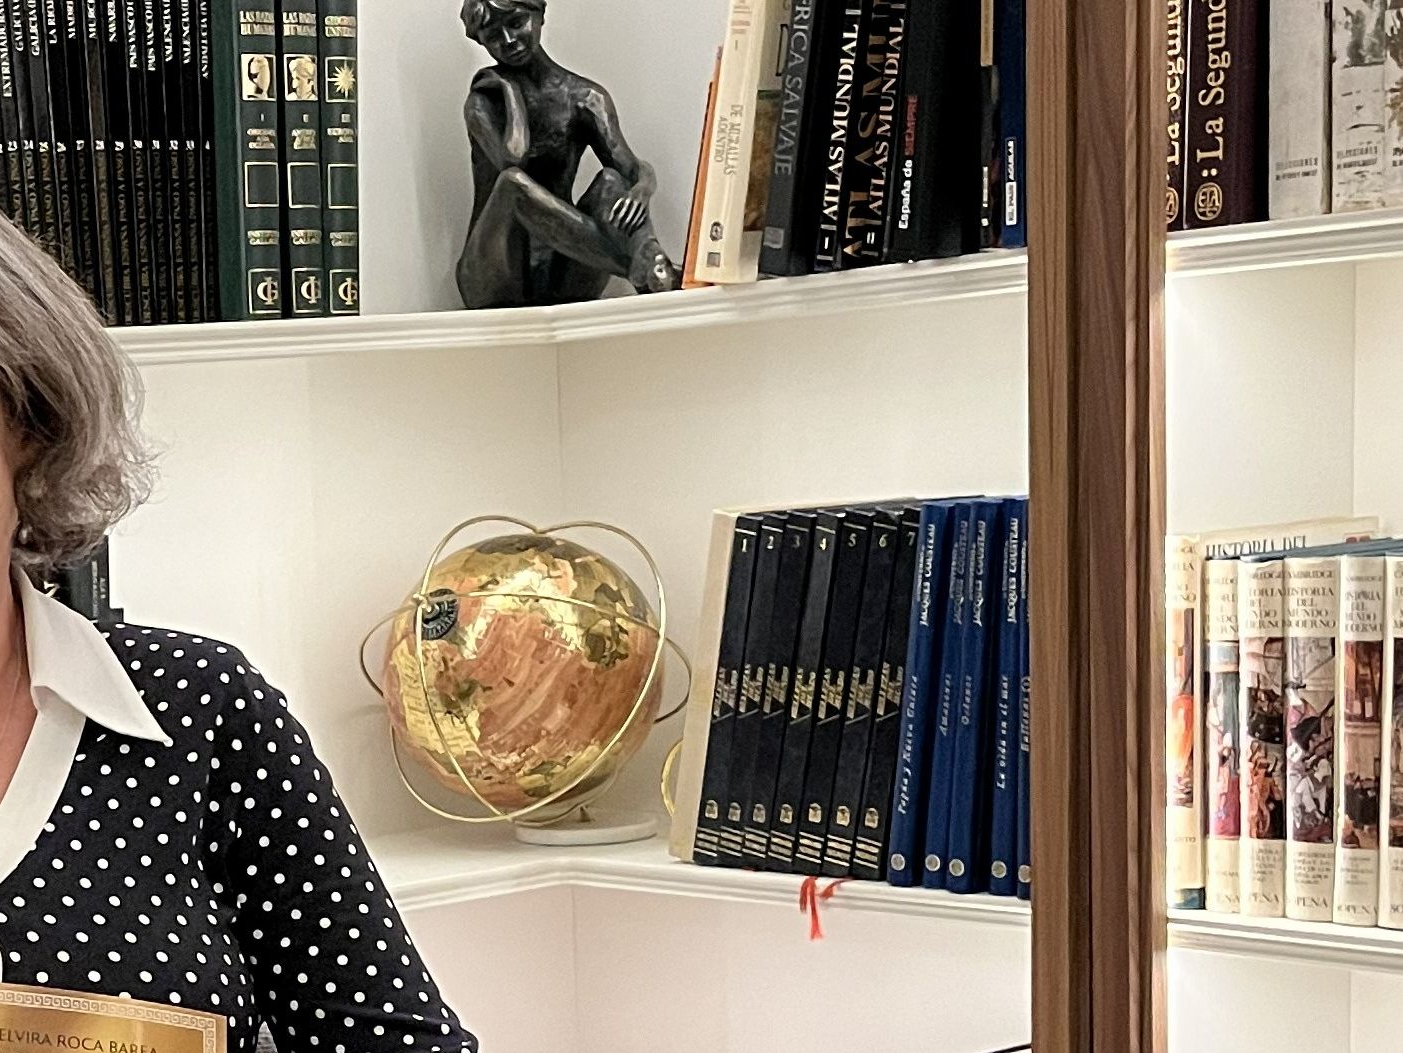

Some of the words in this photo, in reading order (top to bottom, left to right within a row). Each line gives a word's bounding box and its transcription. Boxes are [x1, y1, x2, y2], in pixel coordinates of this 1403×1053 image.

[788, 0, 812, 68] RICA
[830, 24, 859, 142] MUNDIAL
[876, 18, 905, 137] MUNDIAL
[774, 74, 803, 177] SALVAJE
[1195, 116, 1224, 164] La
[822, 146, 845, 220] ATLAS
[869, 141, 889, 215] ATLAS
[897, 179, 912, 230] España
[741, 538, 748, 552] 1
[766, 535, 774, 550] 2
[819, 537, 827, 551] 4
[848, 532, 857, 547] 5
[878, 533, 888, 548] 6
[908, 530, 916, 546] 7
[957, 520, 968, 575] COUSTEAU
[976, 519, 986, 575] COUSTEAU
[1009, 517, 1019, 573] COUSTEAU
[920, 582, 931, 626] JACQUES
[1006, 577, 1018, 624] JACQUES
[0, 1027, 52, 1046] ELVIRA
[56, 1034, 104, 1053] ROCA
